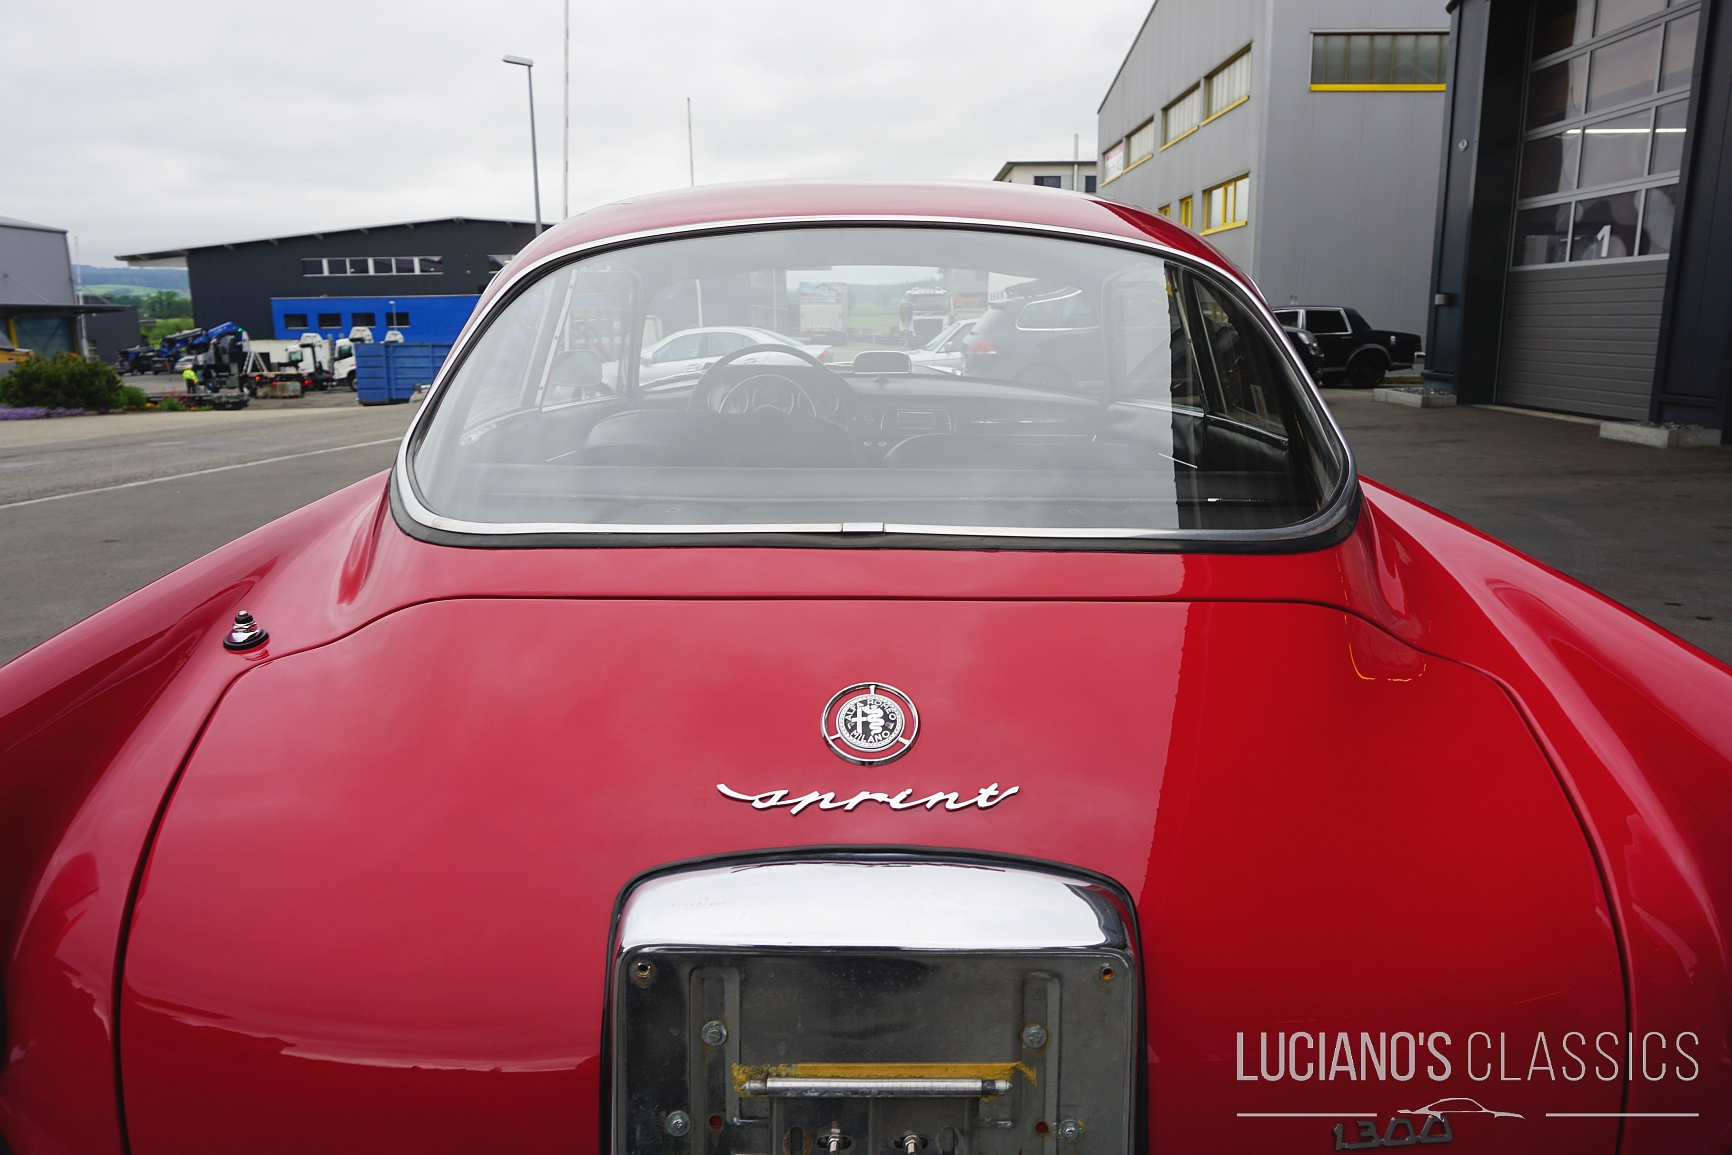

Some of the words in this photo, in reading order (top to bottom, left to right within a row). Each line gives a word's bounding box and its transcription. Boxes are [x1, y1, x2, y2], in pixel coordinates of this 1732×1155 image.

[1596, 224, 1611, 257] 1
[845, 702, 864, 720] ALFA
[867, 699, 896, 720] ROMEO
[851, 730, 890, 743] MILANO
[716, 782, 1020, 816] sprint
[1333, 1114, 1453, 1151] 1300
